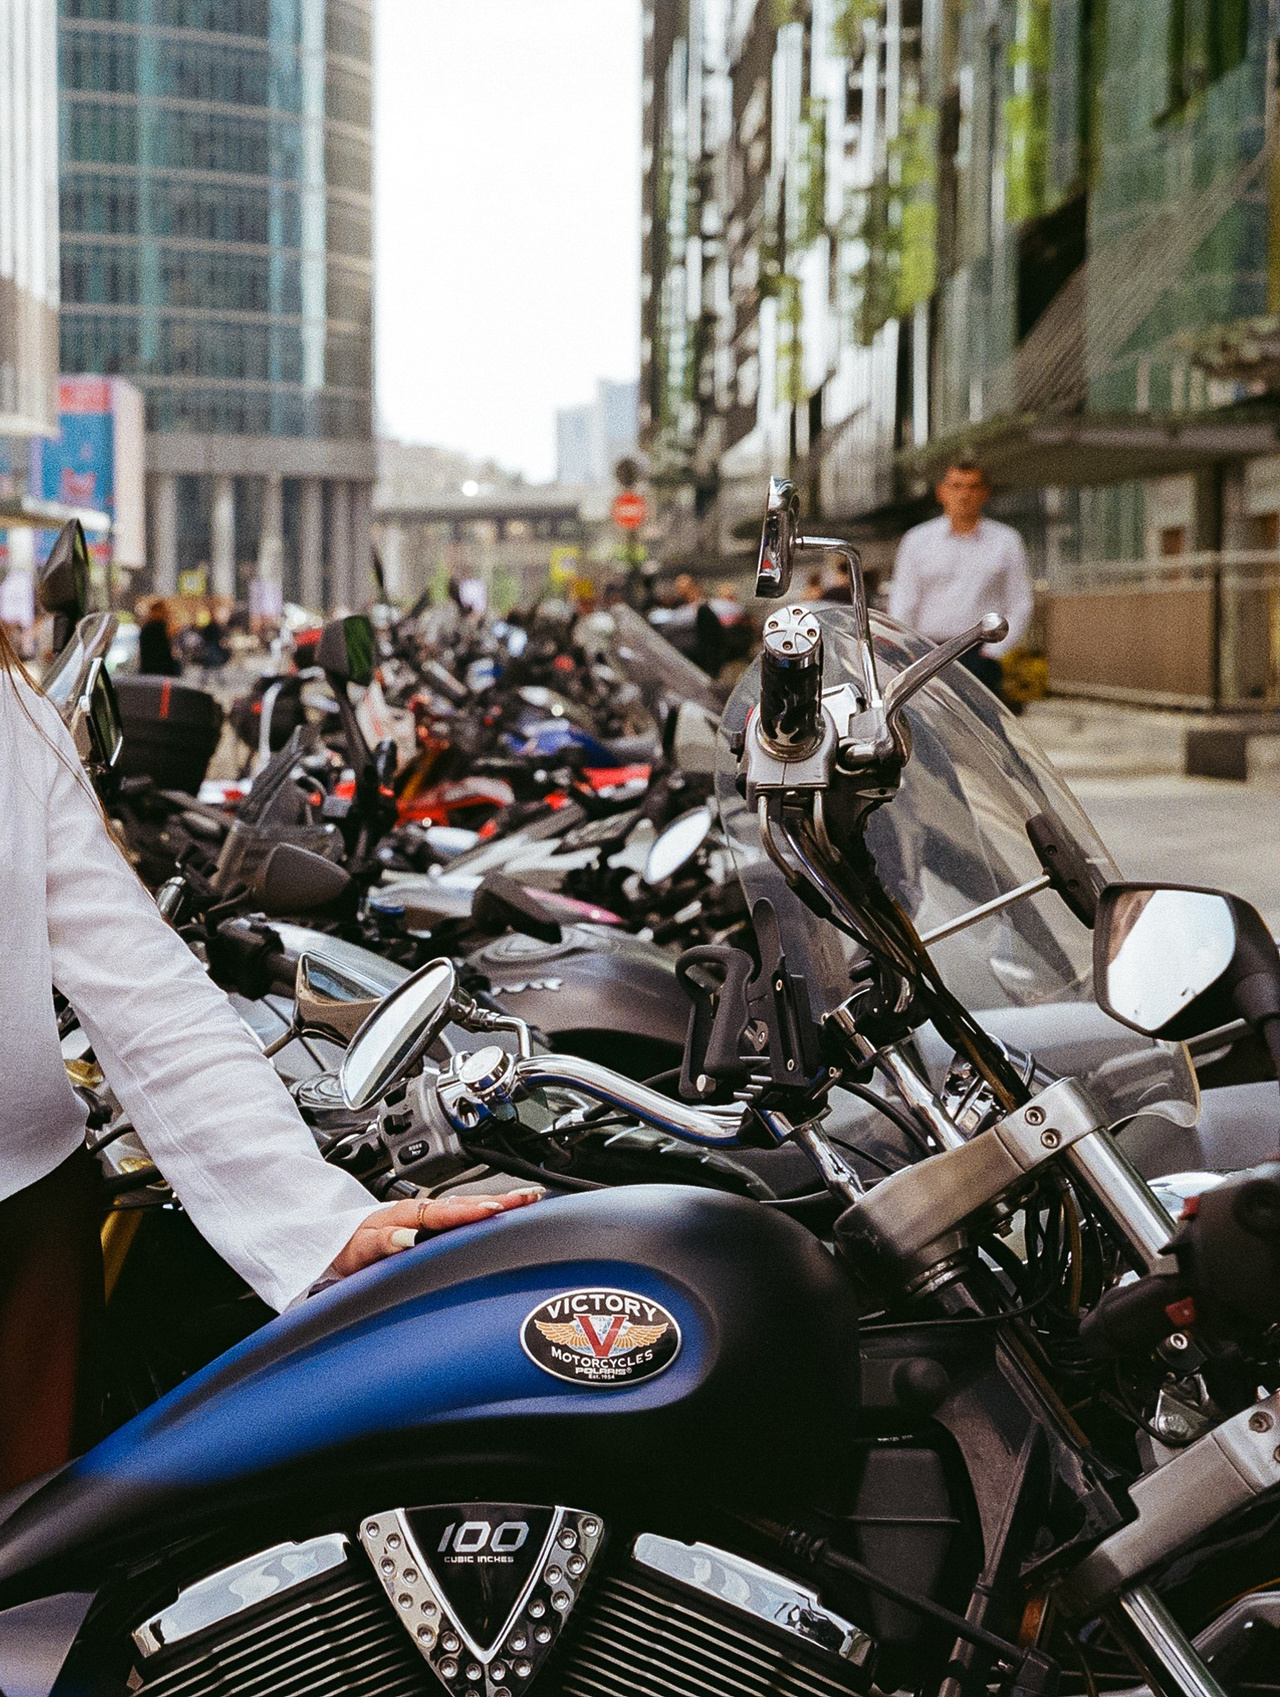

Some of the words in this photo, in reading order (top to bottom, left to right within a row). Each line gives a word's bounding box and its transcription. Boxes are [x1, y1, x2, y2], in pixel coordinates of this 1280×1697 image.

[547, 1294, 656, 1321] VICTORY
[573, 1314, 629, 1358] V
[551, 1346, 653, 1369] MOTORCYCLES
[437, 1521, 530, 1552] 100
[444, 1555, 474, 1563] CUBIC
[477, 1555, 514, 1563] INCHES
